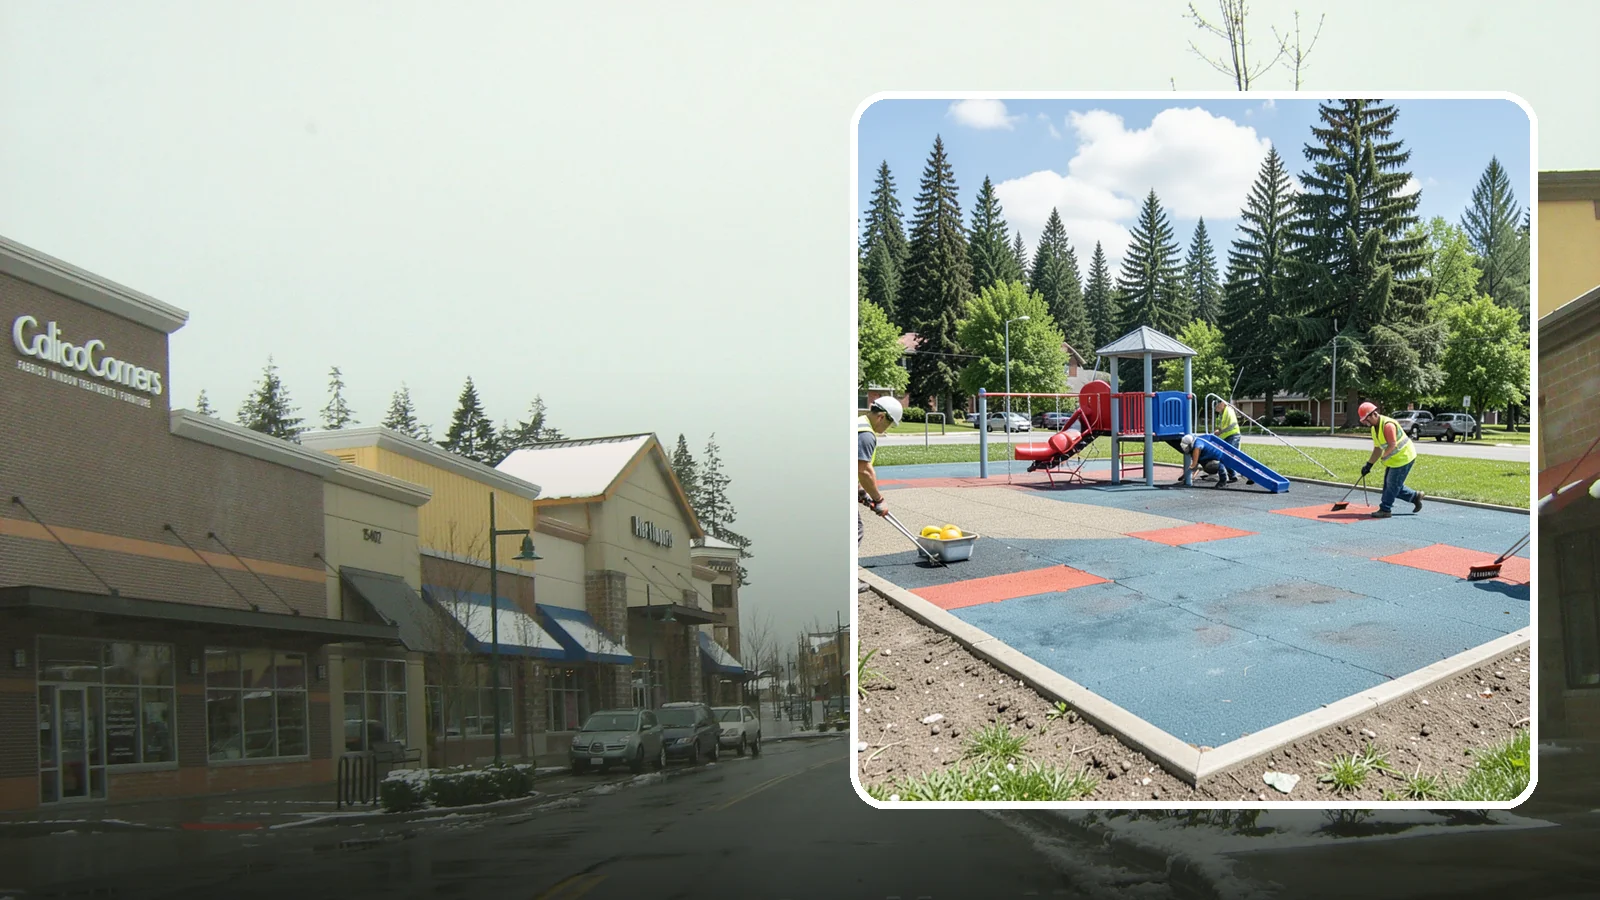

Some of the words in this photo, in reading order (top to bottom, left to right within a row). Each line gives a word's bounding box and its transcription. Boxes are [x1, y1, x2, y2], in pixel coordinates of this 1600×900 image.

[17, 360, 47, 377] FABRICS
[51, 370, 78, 386] WINDOW
[78, 378, 116, 398] TREATMENTS
[120, 391, 152, 408] FURNITURE
